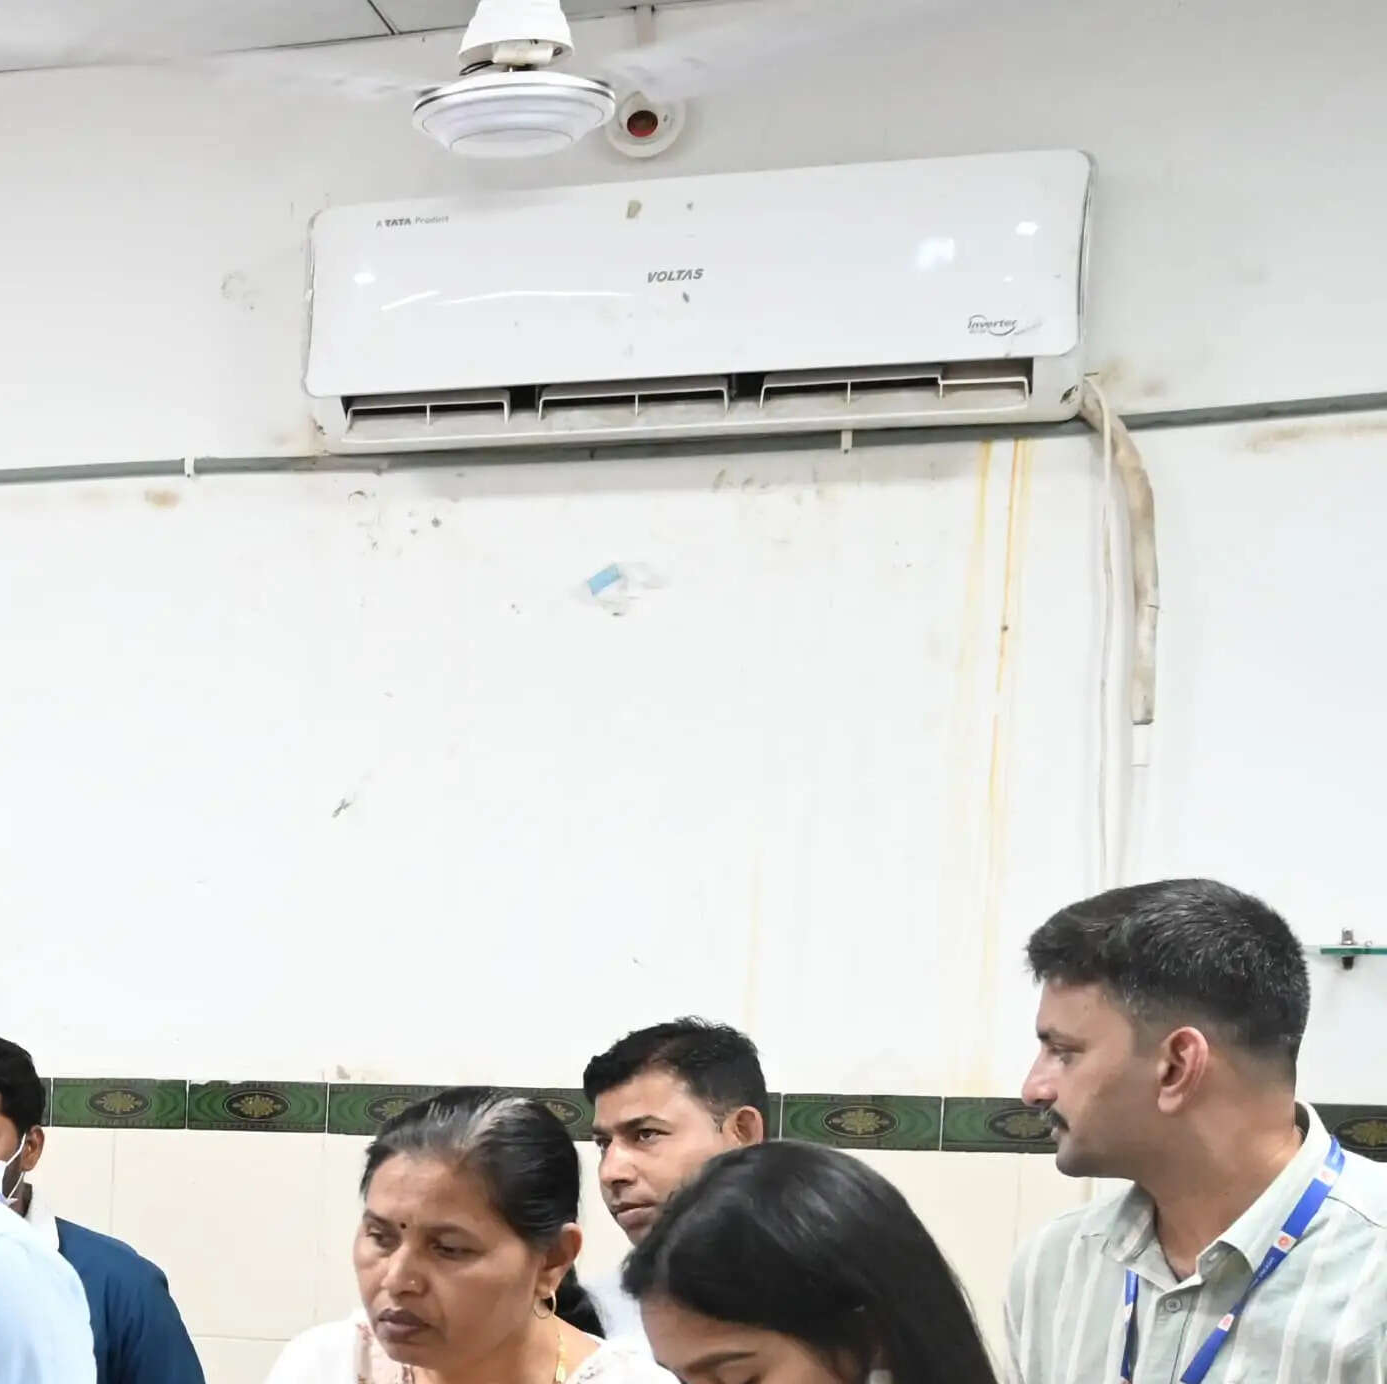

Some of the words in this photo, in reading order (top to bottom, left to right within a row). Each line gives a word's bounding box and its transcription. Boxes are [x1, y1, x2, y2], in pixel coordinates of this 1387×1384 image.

[385, 217, 411, 227] TATA
[415, 215, 449, 225] Product
[647, 268, 704, 283] VOLTAS
[967, 319, 1017, 329] Inverter
